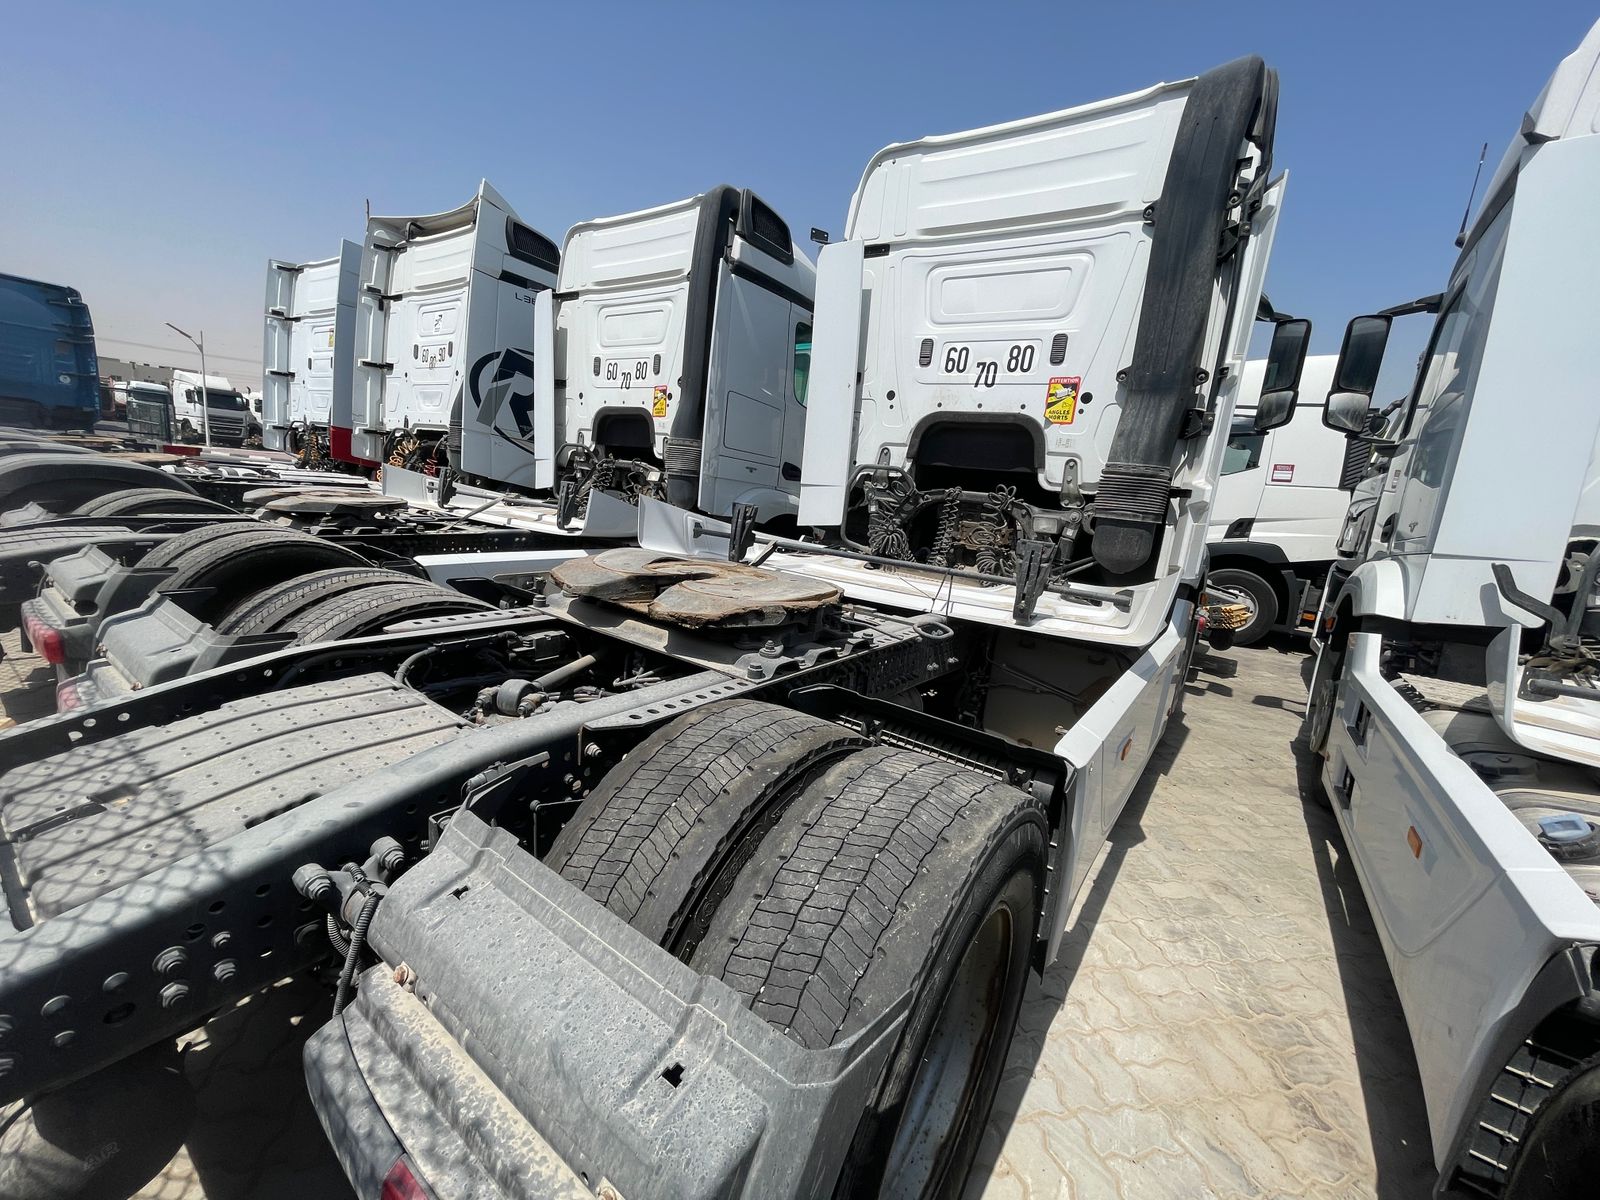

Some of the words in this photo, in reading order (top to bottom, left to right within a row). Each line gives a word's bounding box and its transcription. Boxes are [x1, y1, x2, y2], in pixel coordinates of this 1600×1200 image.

[607, 363, 618, 380] 60
[635, 361, 647, 380] 80
[944, 346, 970, 374] 60
[1007, 345, 1035, 373] 80
[621, 372, 631, 389] 70
[974, 361, 998, 388] 70
